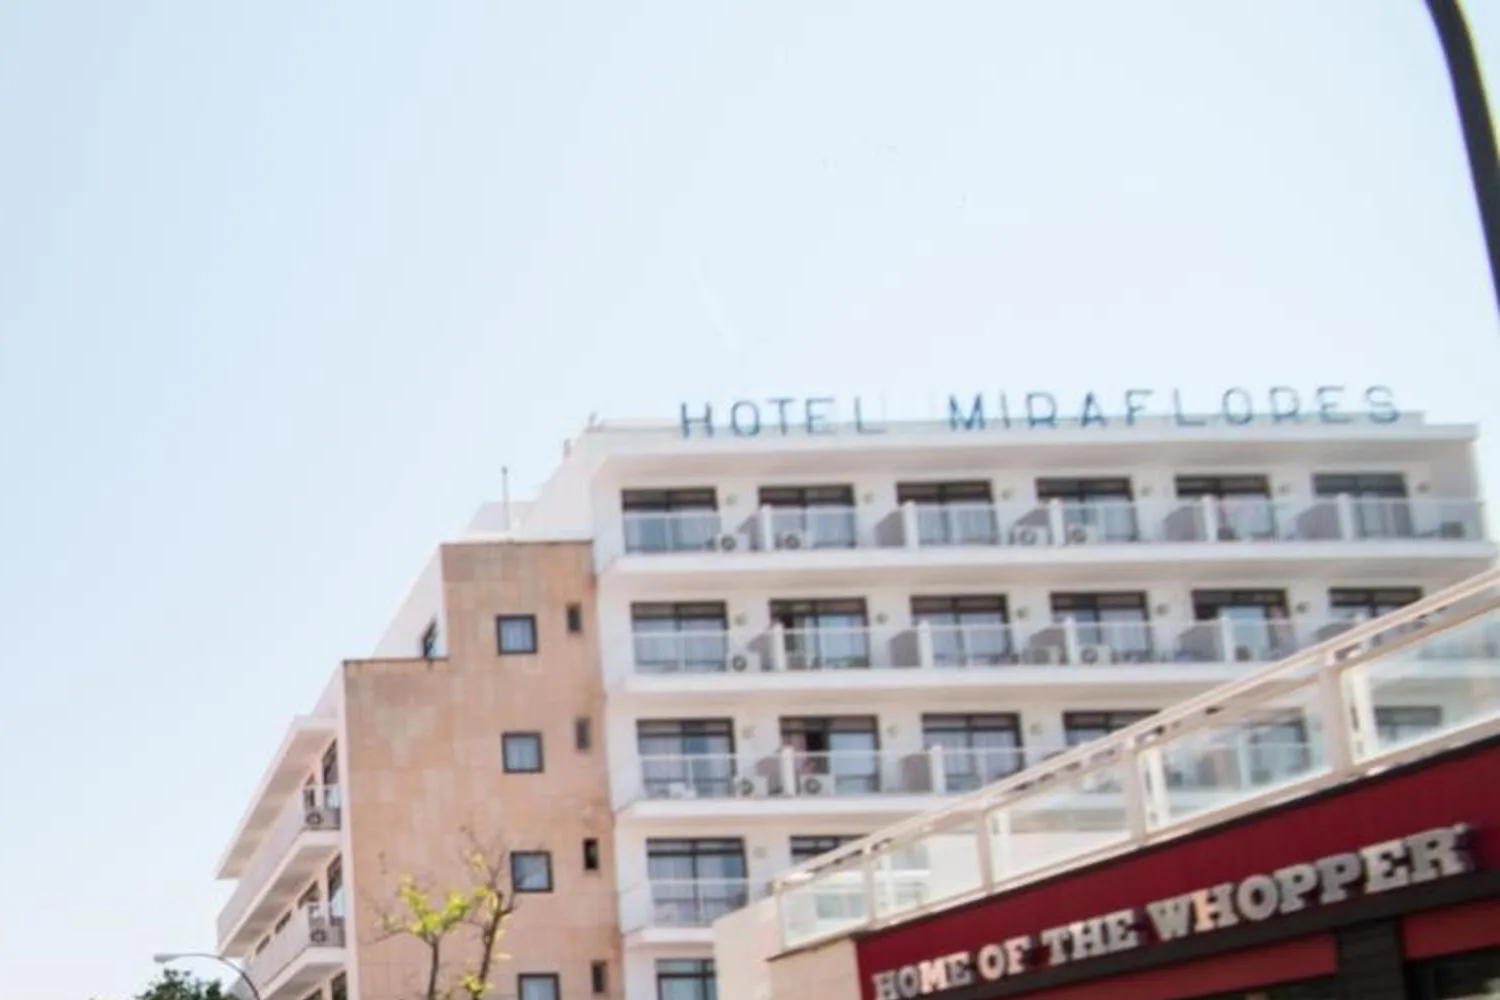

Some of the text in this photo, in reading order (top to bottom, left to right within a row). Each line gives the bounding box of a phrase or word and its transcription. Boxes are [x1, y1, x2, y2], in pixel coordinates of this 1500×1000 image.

[679, 384, 1402, 438] HOTEL MIRAFLORES
[977, 934, 1033, 982] OF
[1040, 909, 1141, 967] THE
[1145, 824, 1468, 942] WHOPPER
